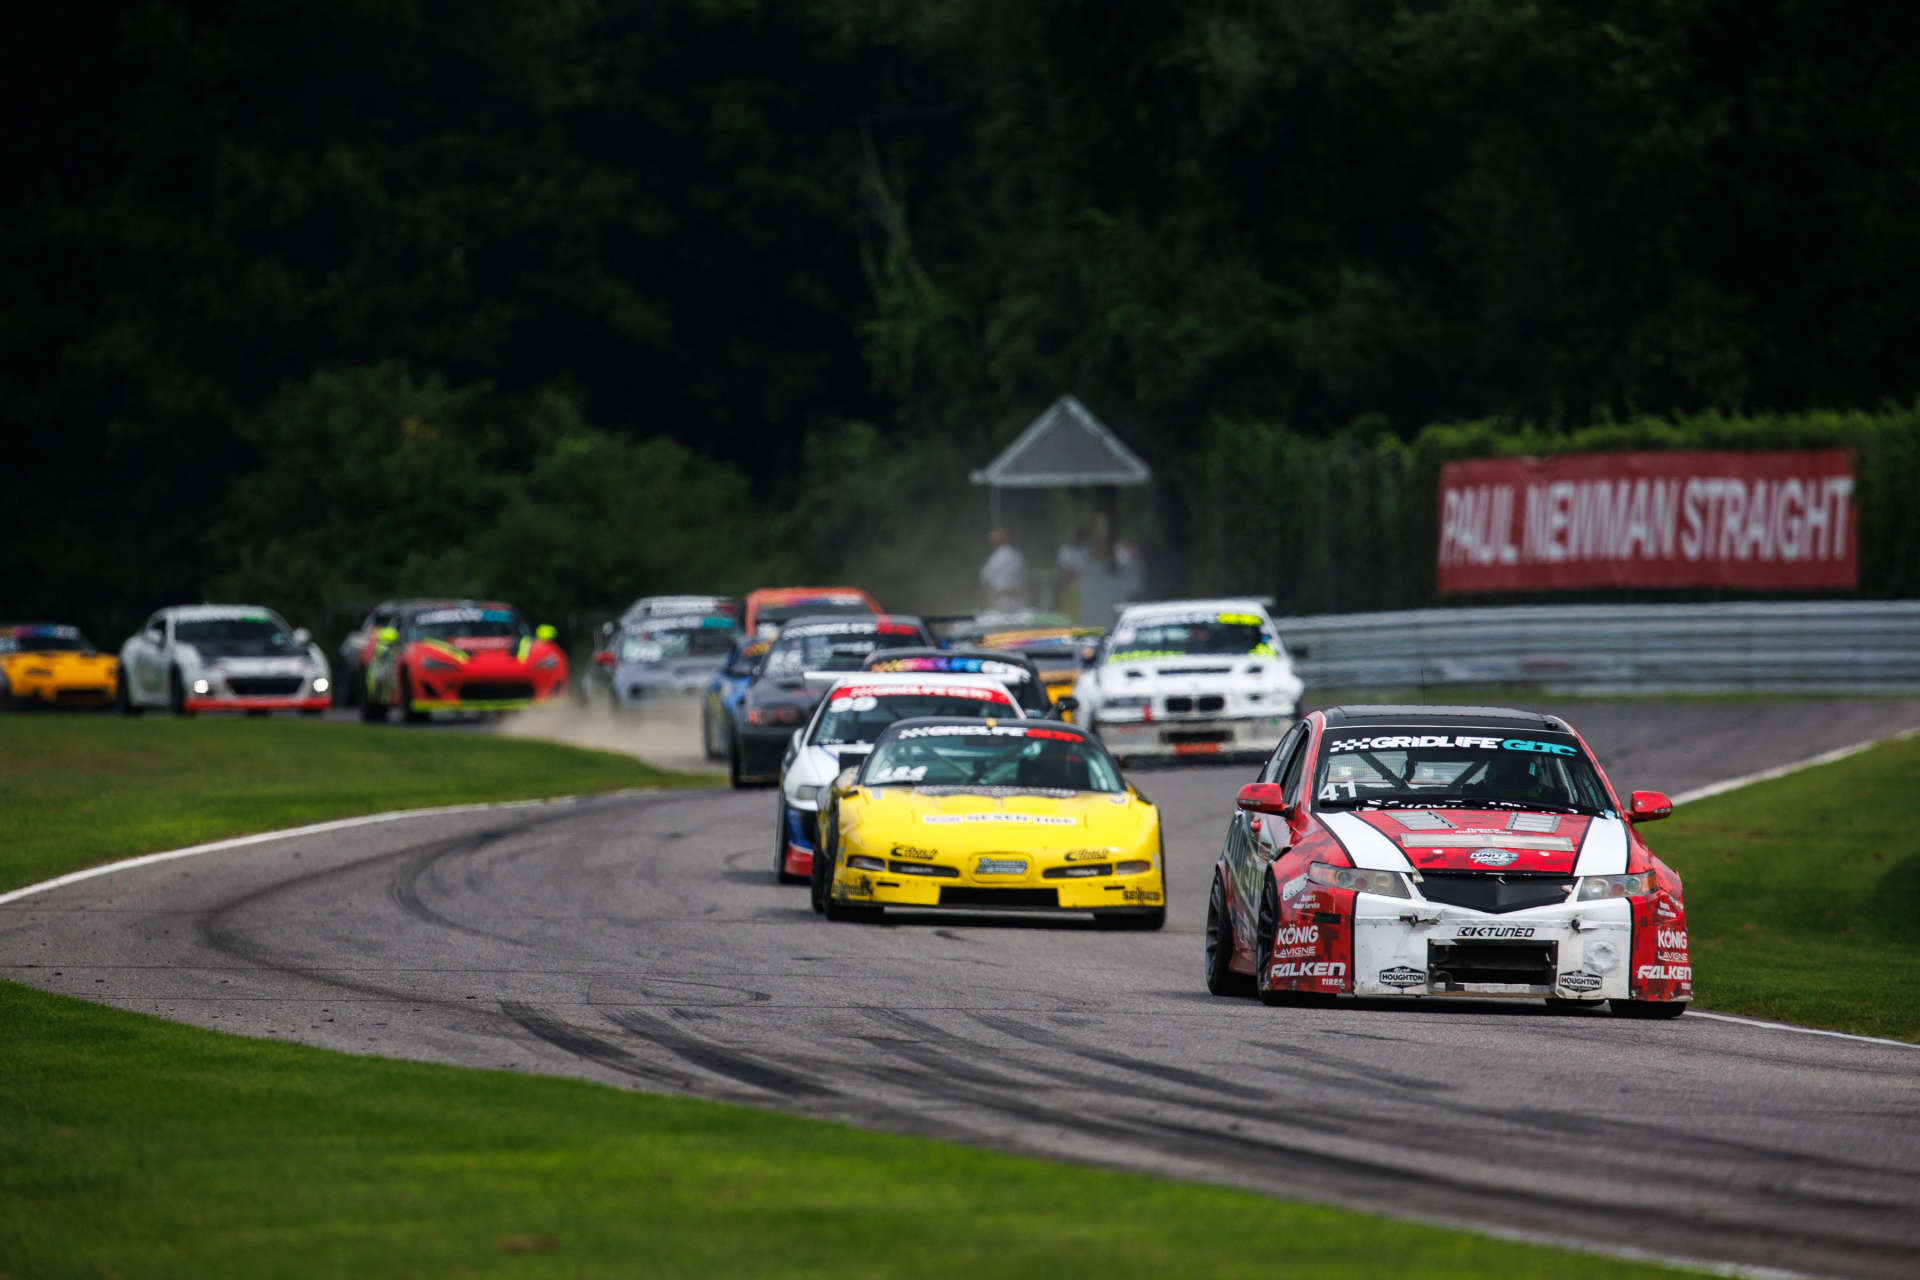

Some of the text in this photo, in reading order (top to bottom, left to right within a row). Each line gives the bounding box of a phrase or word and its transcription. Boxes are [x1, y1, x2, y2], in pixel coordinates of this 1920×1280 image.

[1440, 475, 1855, 568] PAUL NEWMAN STRAIGHT
[1370, 735, 1578, 757] GRIDLIFE GLTC
[1319, 781, 1357, 801] 41
[1277, 924, 1319, 945] KÖNIG
[1657, 929, 1687, 949] KÖNIG
[1274, 946, 1317, 958] LAVIGNE
[1271, 962, 1346, 977] FALKEN
[1637, 965, 1692, 980] FALKEN
[1561, 977, 1601, 986] HOUGHTON
